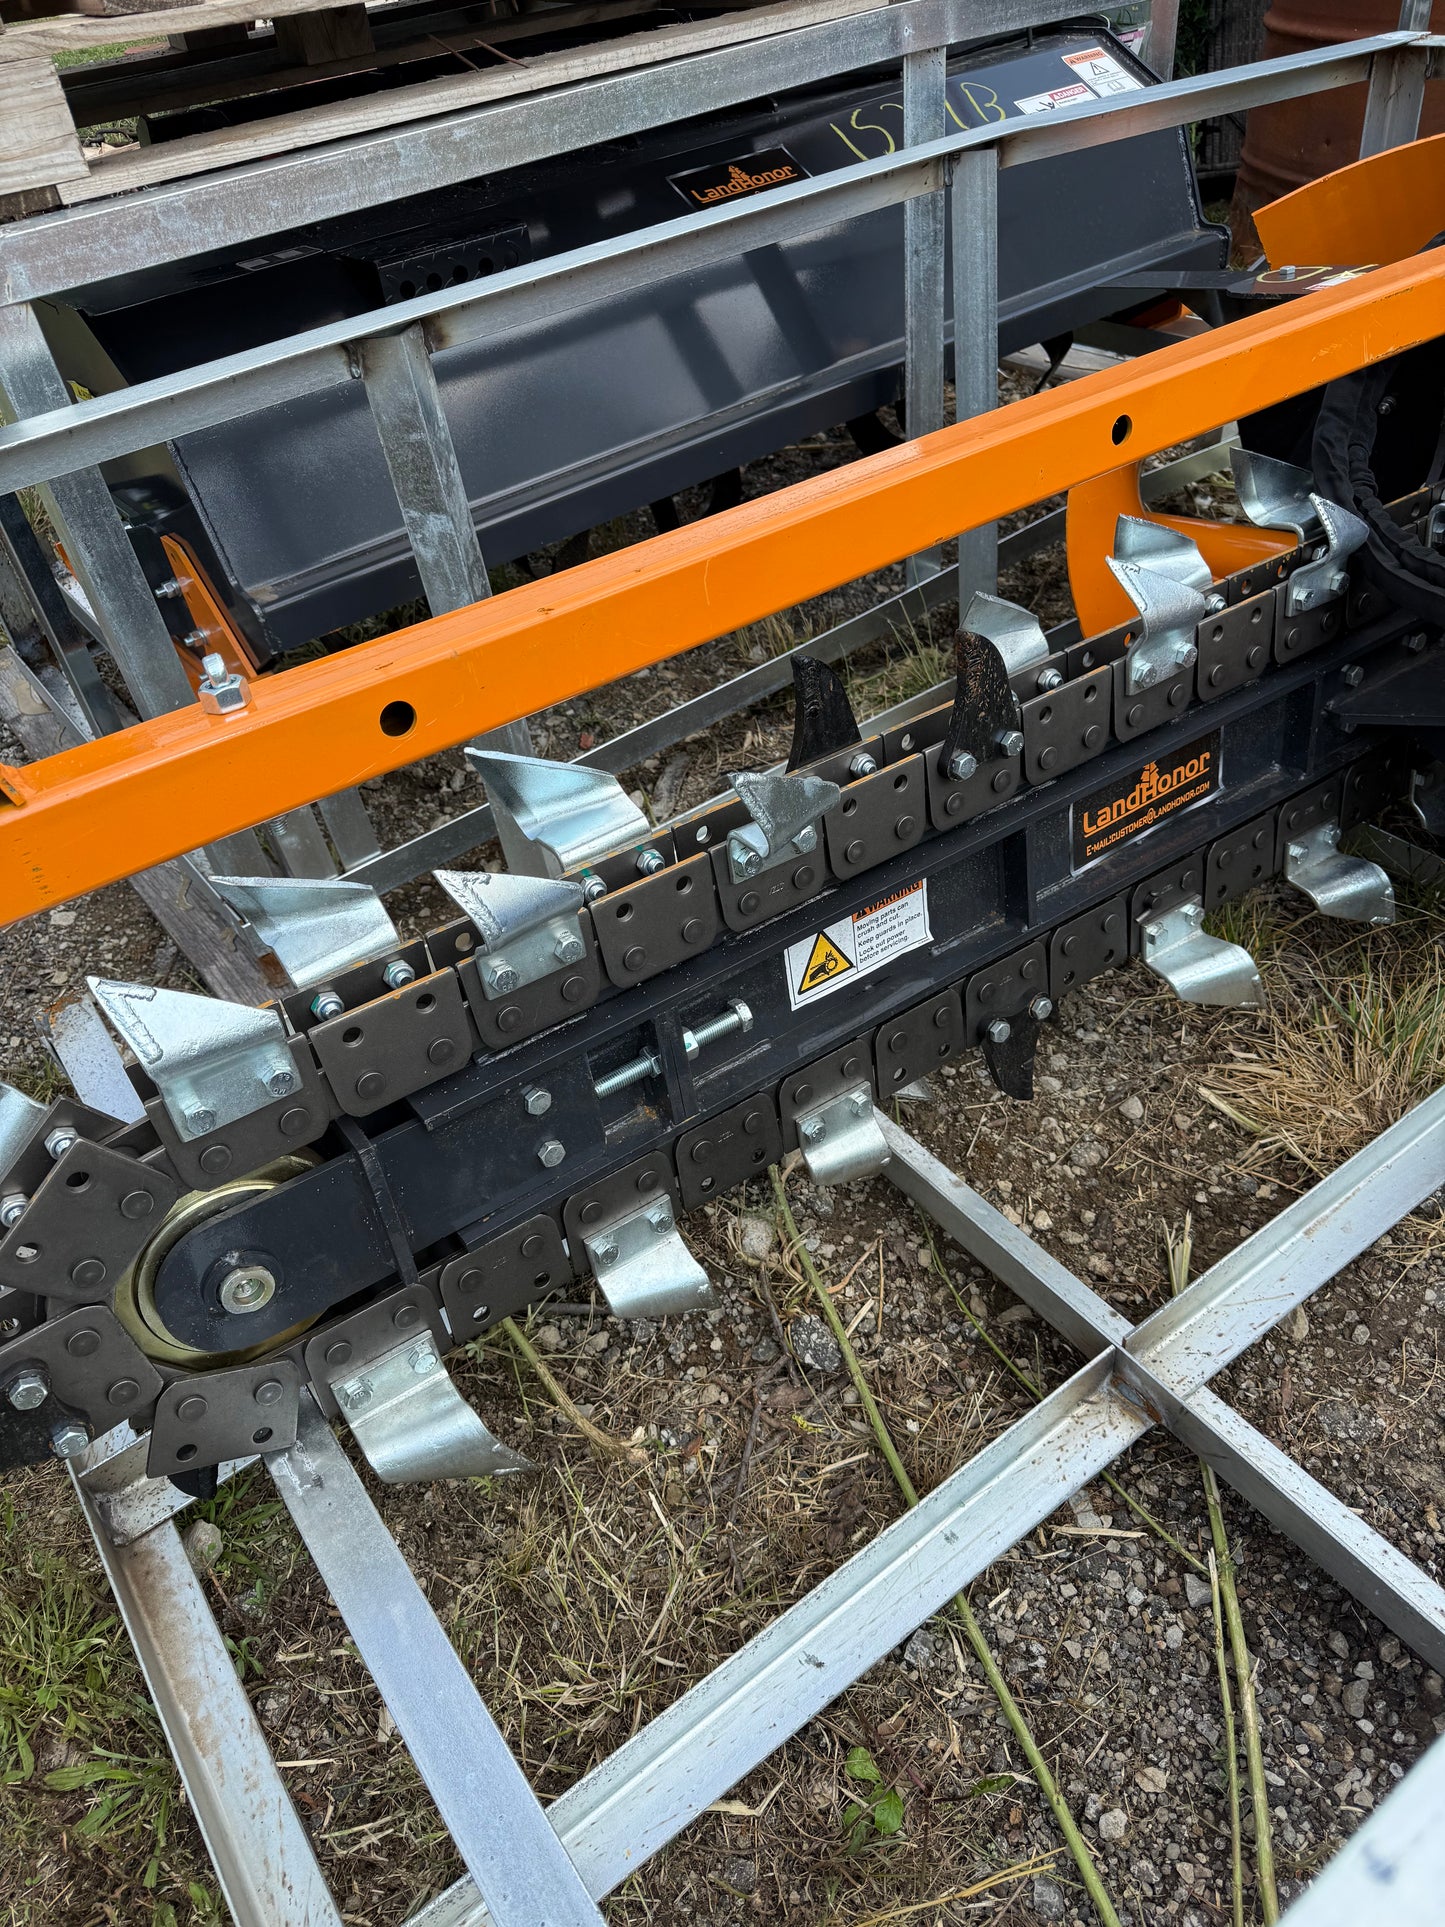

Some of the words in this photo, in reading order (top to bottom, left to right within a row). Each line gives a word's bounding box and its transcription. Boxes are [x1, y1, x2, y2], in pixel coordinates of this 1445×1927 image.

[1057, 86, 1087, 98] DANGER
[691, 165, 795, 202] LandHonor
[1083, 751, 1211, 834] LandHonor
[857, 916, 879, 931] Moving
[880, 908, 896, 921] parts
[897, 902, 909, 911] can
[857, 926, 875, 938] crush
[876, 920, 888, 929] and
[889, 914, 900, 923] cut.
[858, 936, 874, 947] Keep
[875, 925, 896, 939] guards
[905, 912, 922, 925] place.
[859, 947, 875, 956] Lock
[876, 939, 886, 949] out
[887, 930, 906, 943] power
[860, 951, 880, 964] before
[881, 935, 909, 952] servicing.
